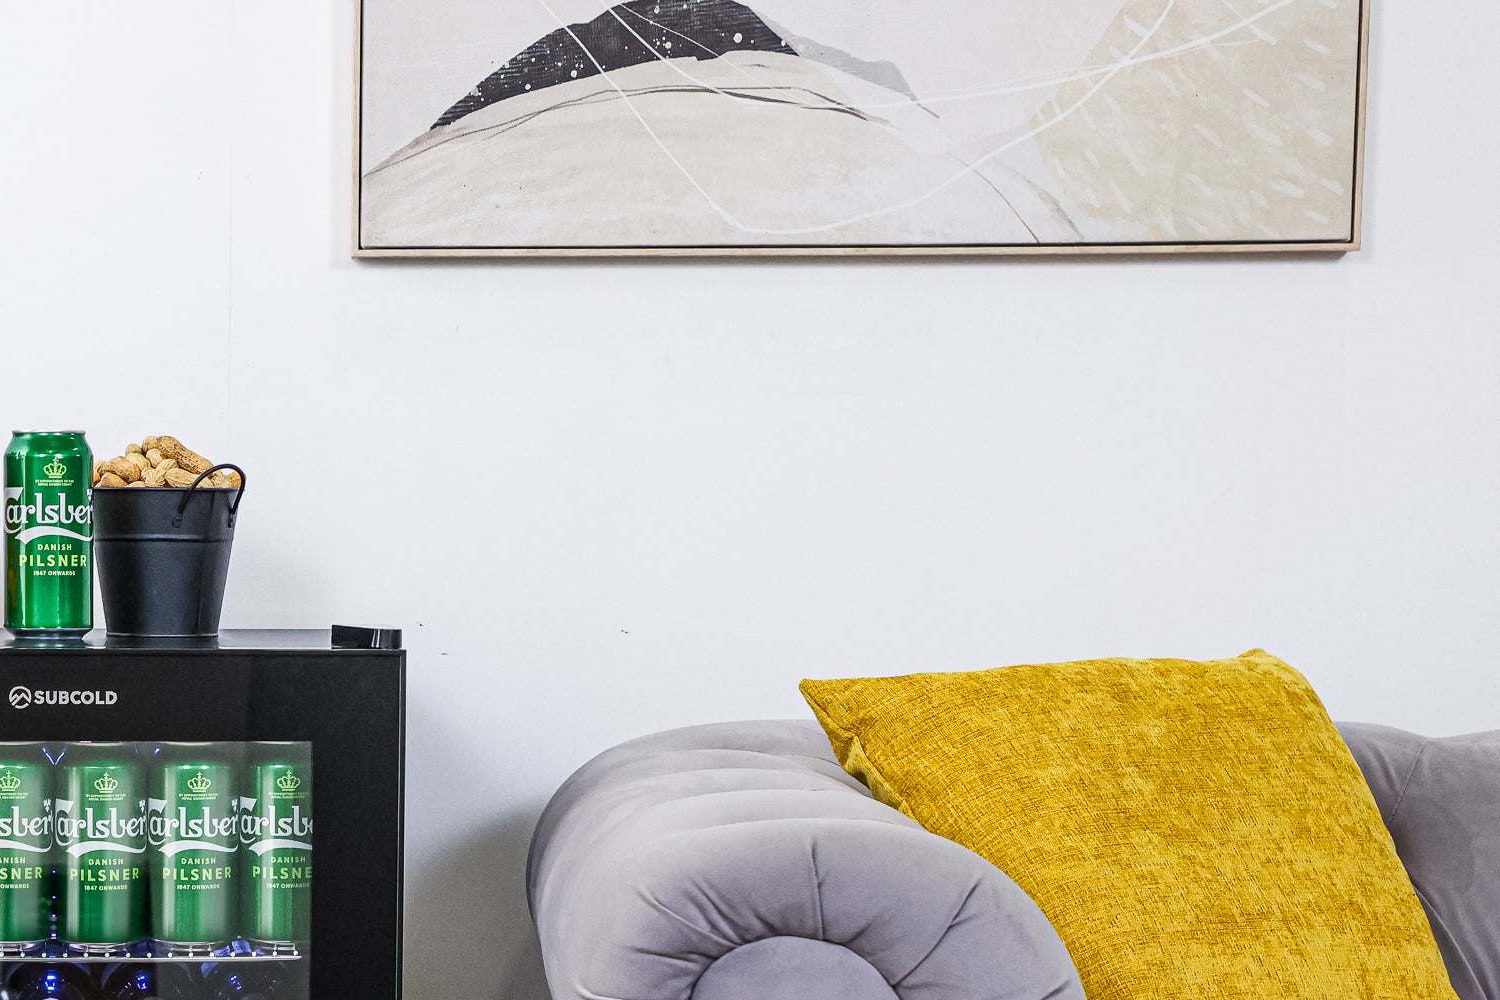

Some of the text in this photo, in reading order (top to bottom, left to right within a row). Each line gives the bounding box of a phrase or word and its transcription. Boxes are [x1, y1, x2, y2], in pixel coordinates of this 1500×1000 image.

[4, 487, 94, 544] Carlsber
[37, 543, 72, 551] DANISH
[19, 554, 87, 567] PILSNER
[33, 690, 118, 705] SUBCOLD
[55, 798, 147, 859] Carlsber
[148, 798, 238, 858] Carlsber
[88, 858, 124, 866] DANISH
[181, 857, 216, 865] DANISH
[70, 867, 139, 882] PILSNER
[162, 866, 232, 881] PILSNER
[252, 865, 313, 880] PILSNE
